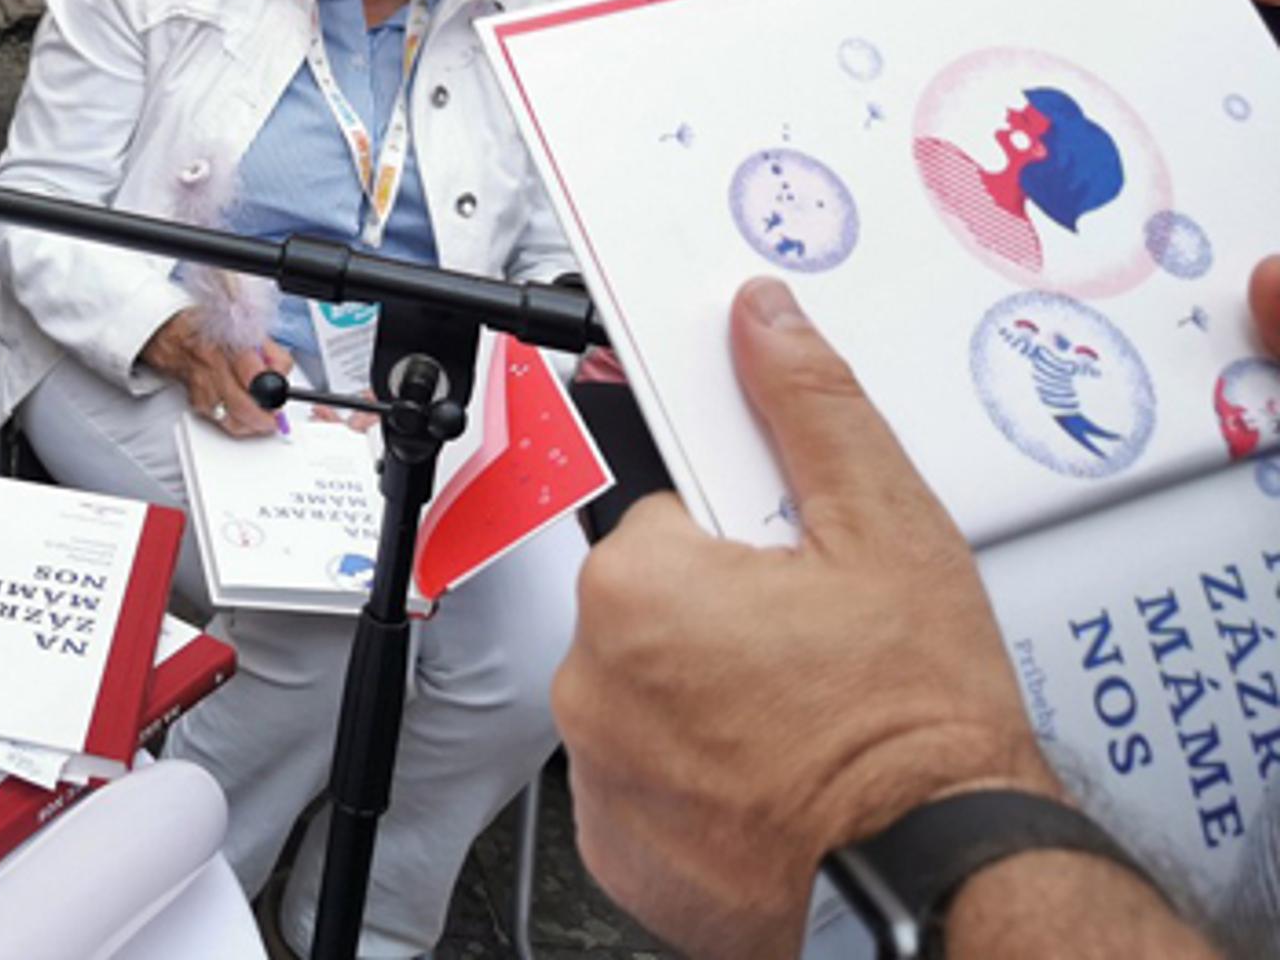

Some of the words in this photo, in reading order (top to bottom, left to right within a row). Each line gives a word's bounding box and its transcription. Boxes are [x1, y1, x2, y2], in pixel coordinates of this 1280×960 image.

[33, 564, 108, 590] NOS
[35, 631, 89, 657] NA
[1069, 609, 1153, 776] NOS
[1134, 587, 1245, 848] MÁME
